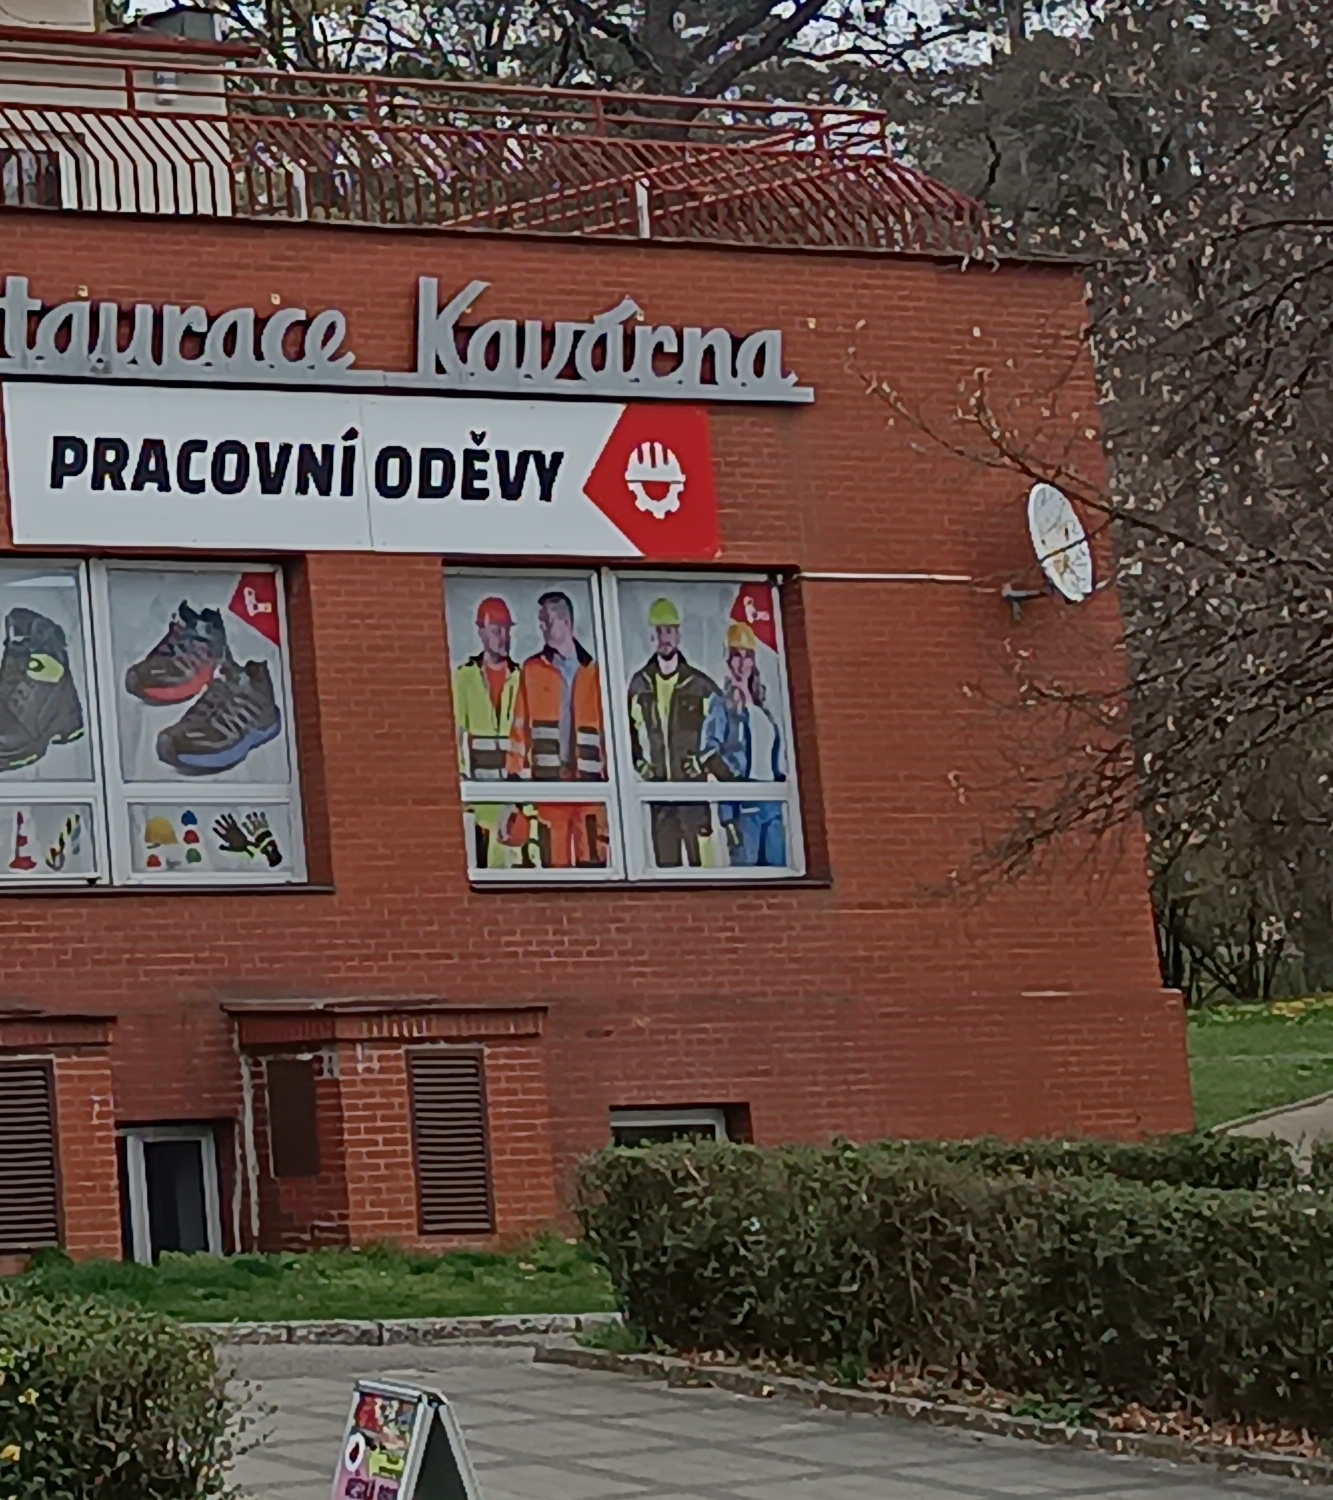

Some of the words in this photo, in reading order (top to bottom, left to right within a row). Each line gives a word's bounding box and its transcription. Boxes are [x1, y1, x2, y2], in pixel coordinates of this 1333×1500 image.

[417, 276, 799, 386] Kavárna
[49, 426, 358, 496] PRACOVNÍ
[375, 430, 563, 502] ODĚVY
